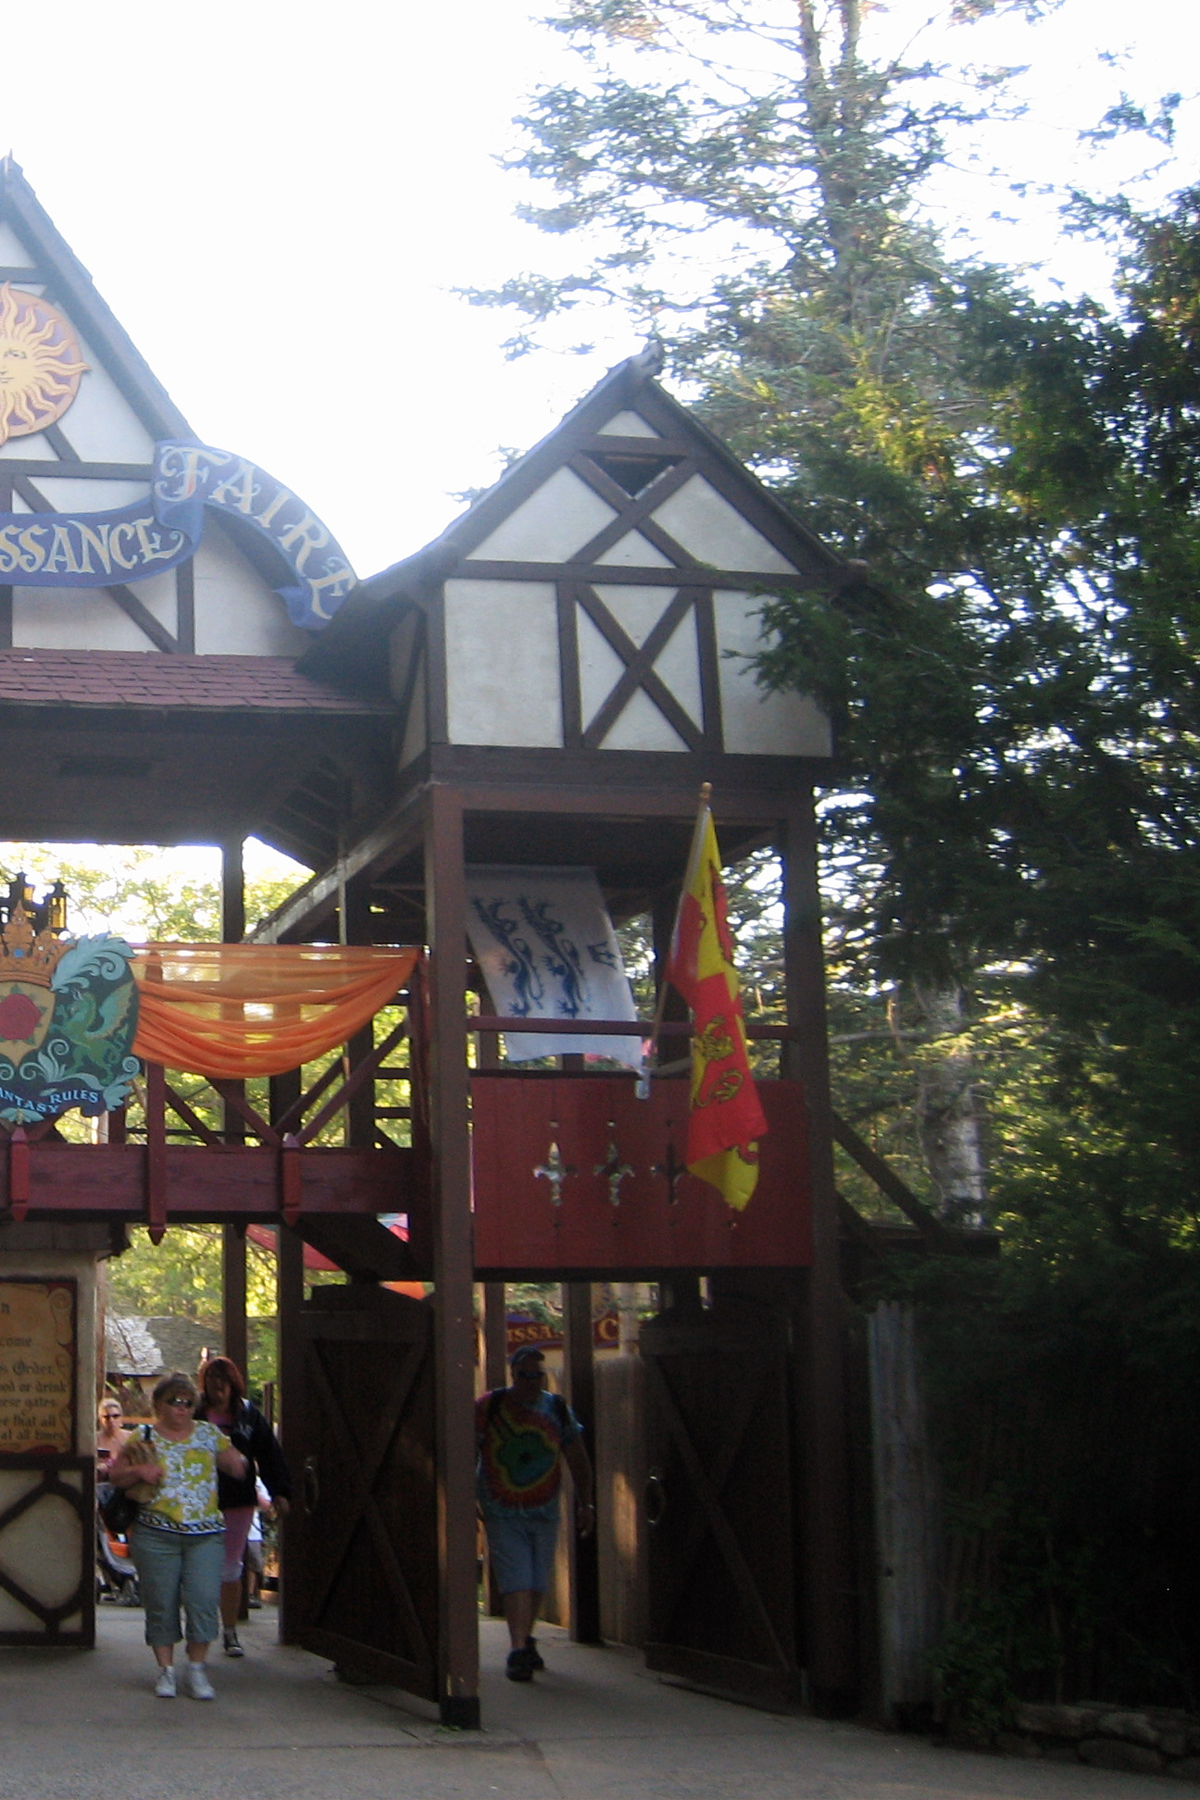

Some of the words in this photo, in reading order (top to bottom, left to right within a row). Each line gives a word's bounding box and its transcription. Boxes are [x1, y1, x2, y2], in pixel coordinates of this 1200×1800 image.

[155, 446, 357, 620] FAIRE
[50, 1088, 99, 1105] RULES
[35, 1379, 68, 1393] drink
